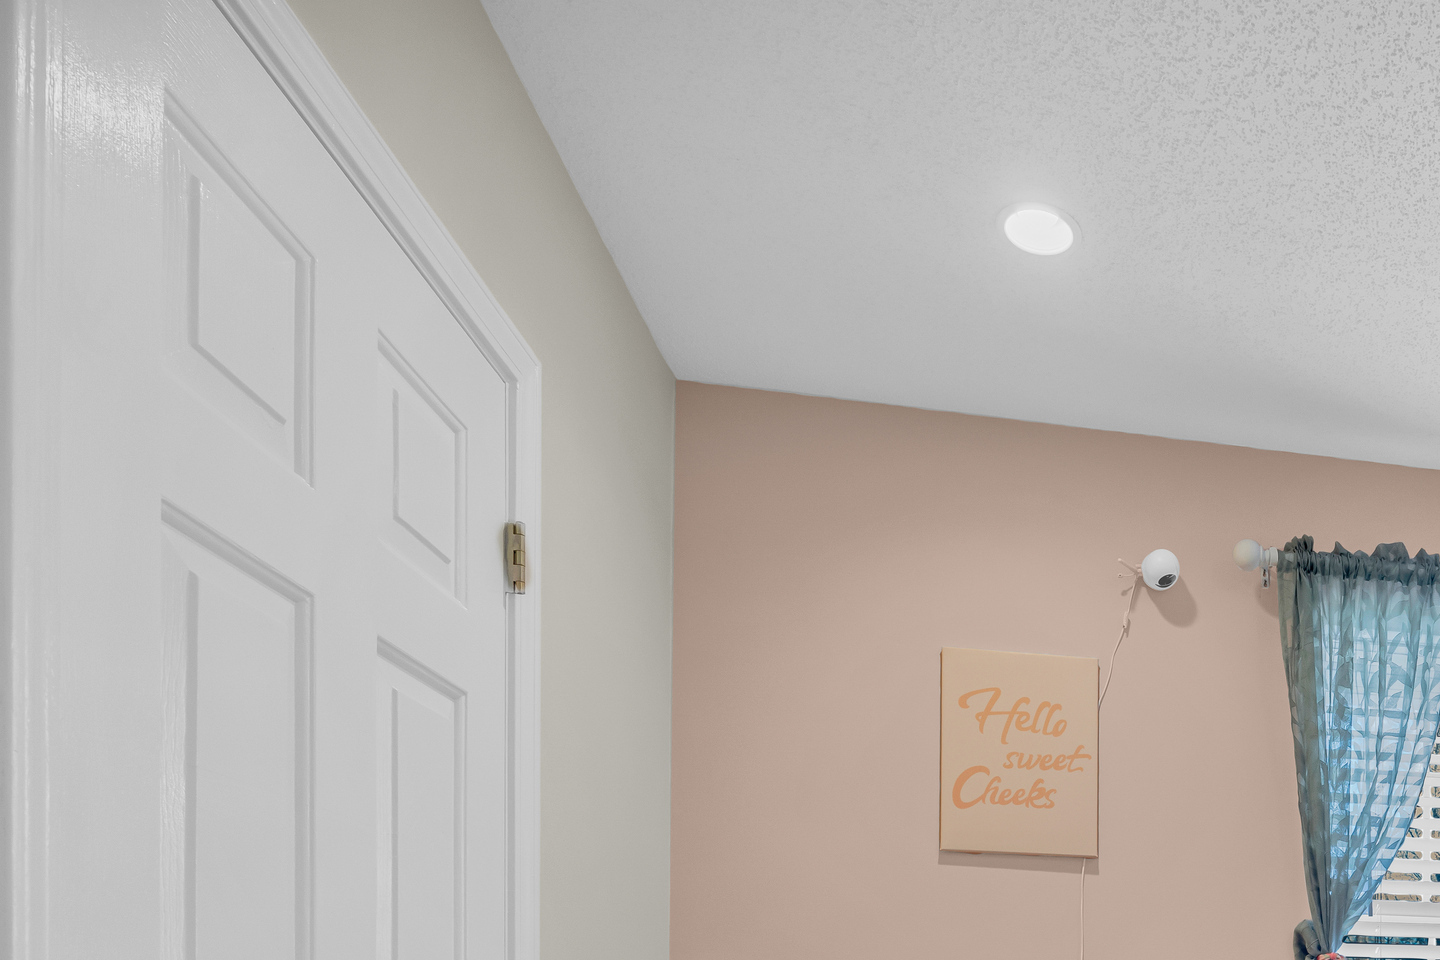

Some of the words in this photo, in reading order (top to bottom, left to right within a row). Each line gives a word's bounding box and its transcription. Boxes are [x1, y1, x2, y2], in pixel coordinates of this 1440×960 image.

[958, 687, 1068, 745] Hello
[1002, 744, 1092, 773] sweet
[952, 765, 1057, 809] Cheeks
